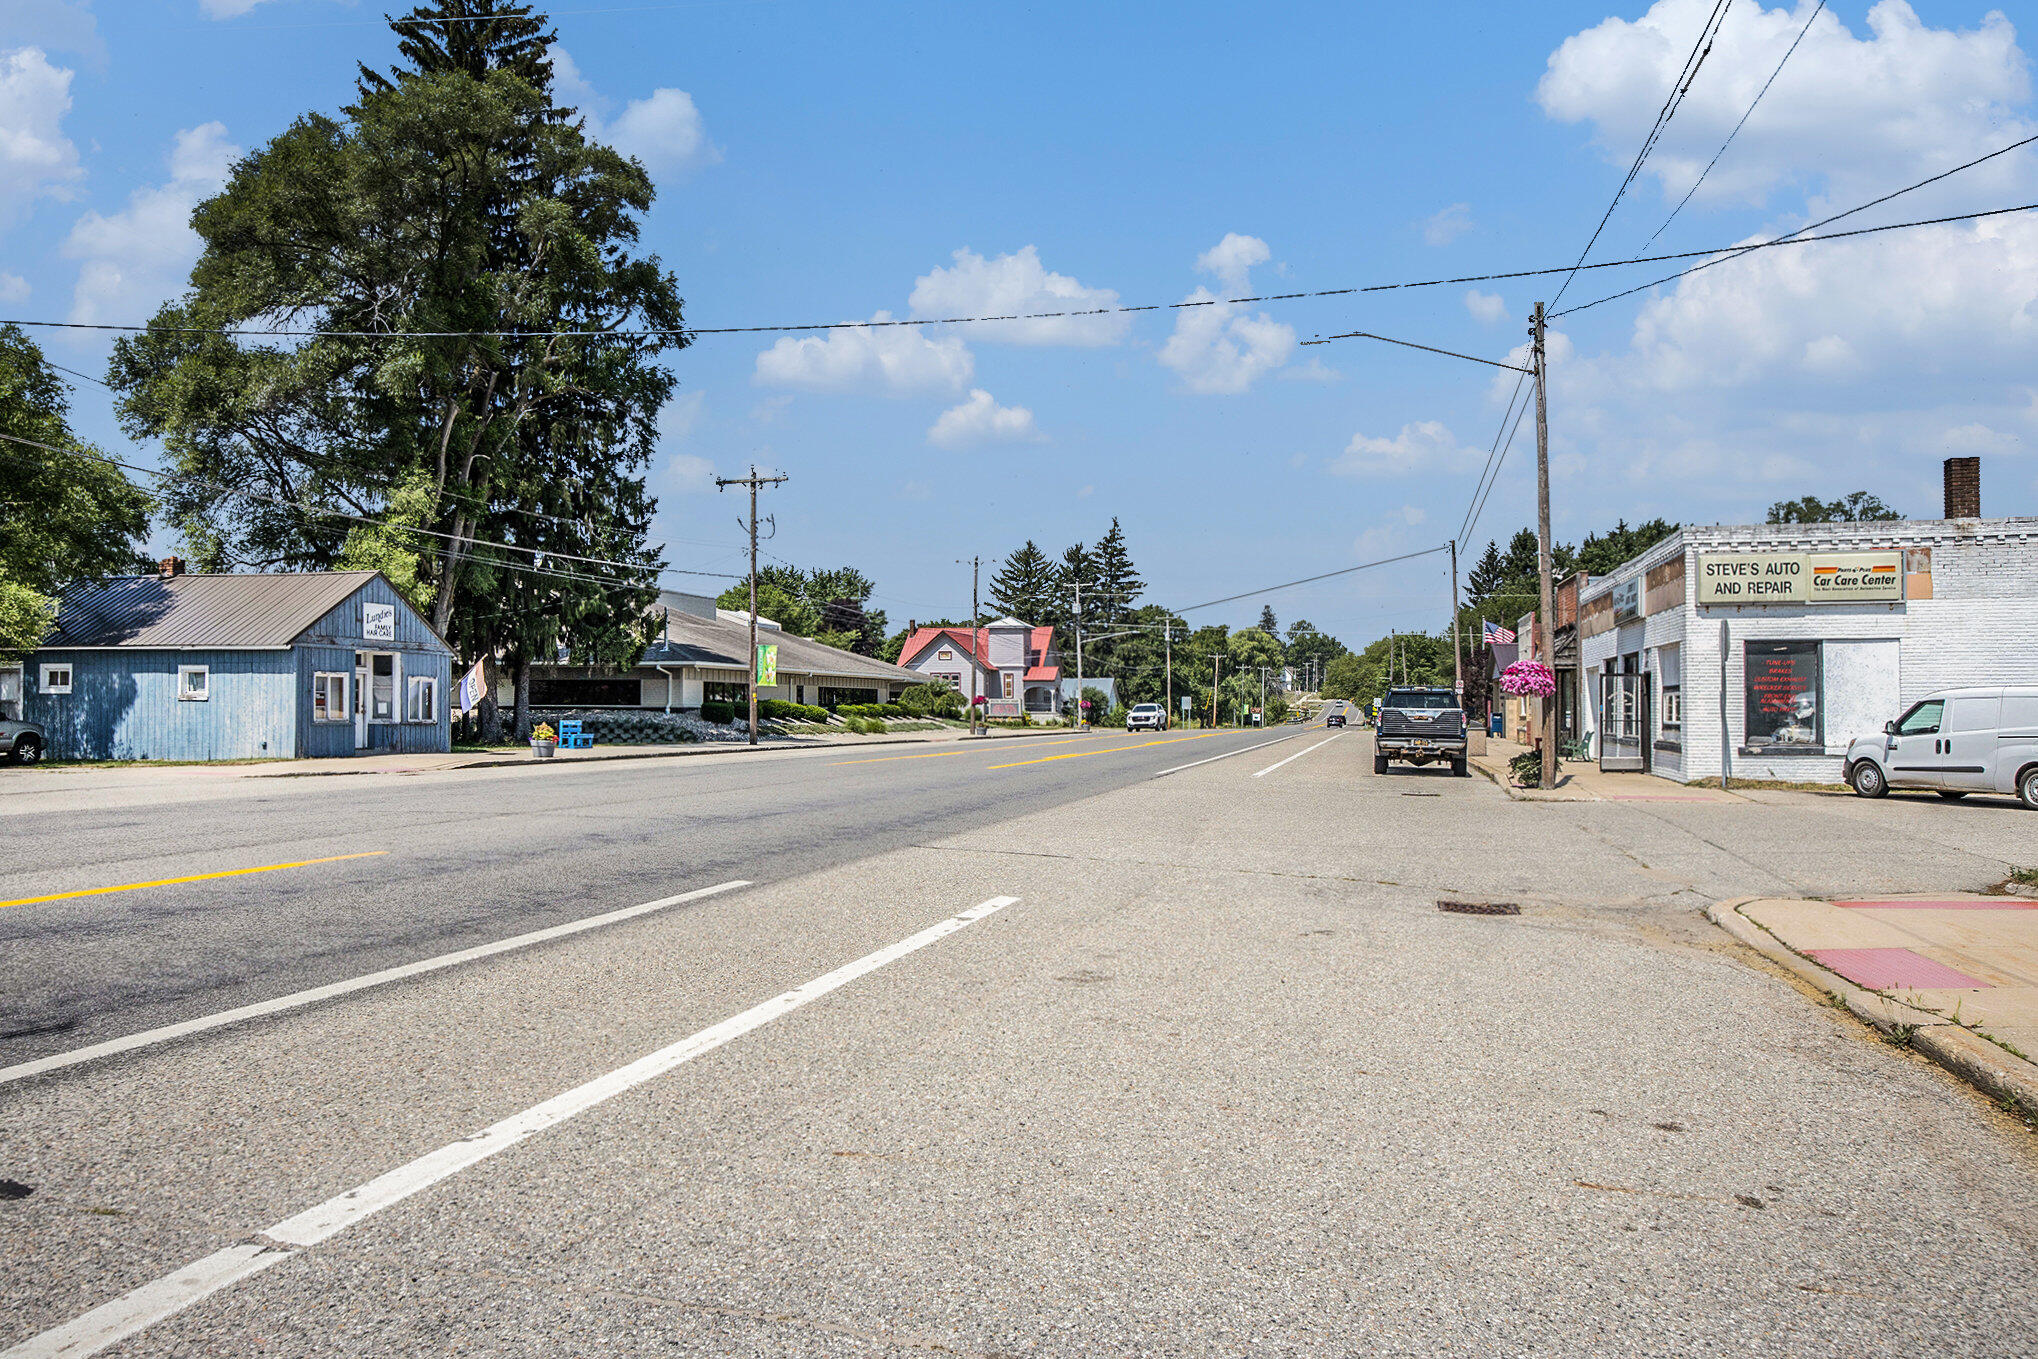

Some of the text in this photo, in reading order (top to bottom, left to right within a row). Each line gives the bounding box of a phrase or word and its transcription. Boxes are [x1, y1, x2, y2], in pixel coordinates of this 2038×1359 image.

[1706, 561, 1800, 576] STEVE'S AUTO
[1814, 574, 1896, 586] Car Care Center
[1714, 581, 1792, 594] AND REPAIR
[470, 678, 480, 701] OPEN
